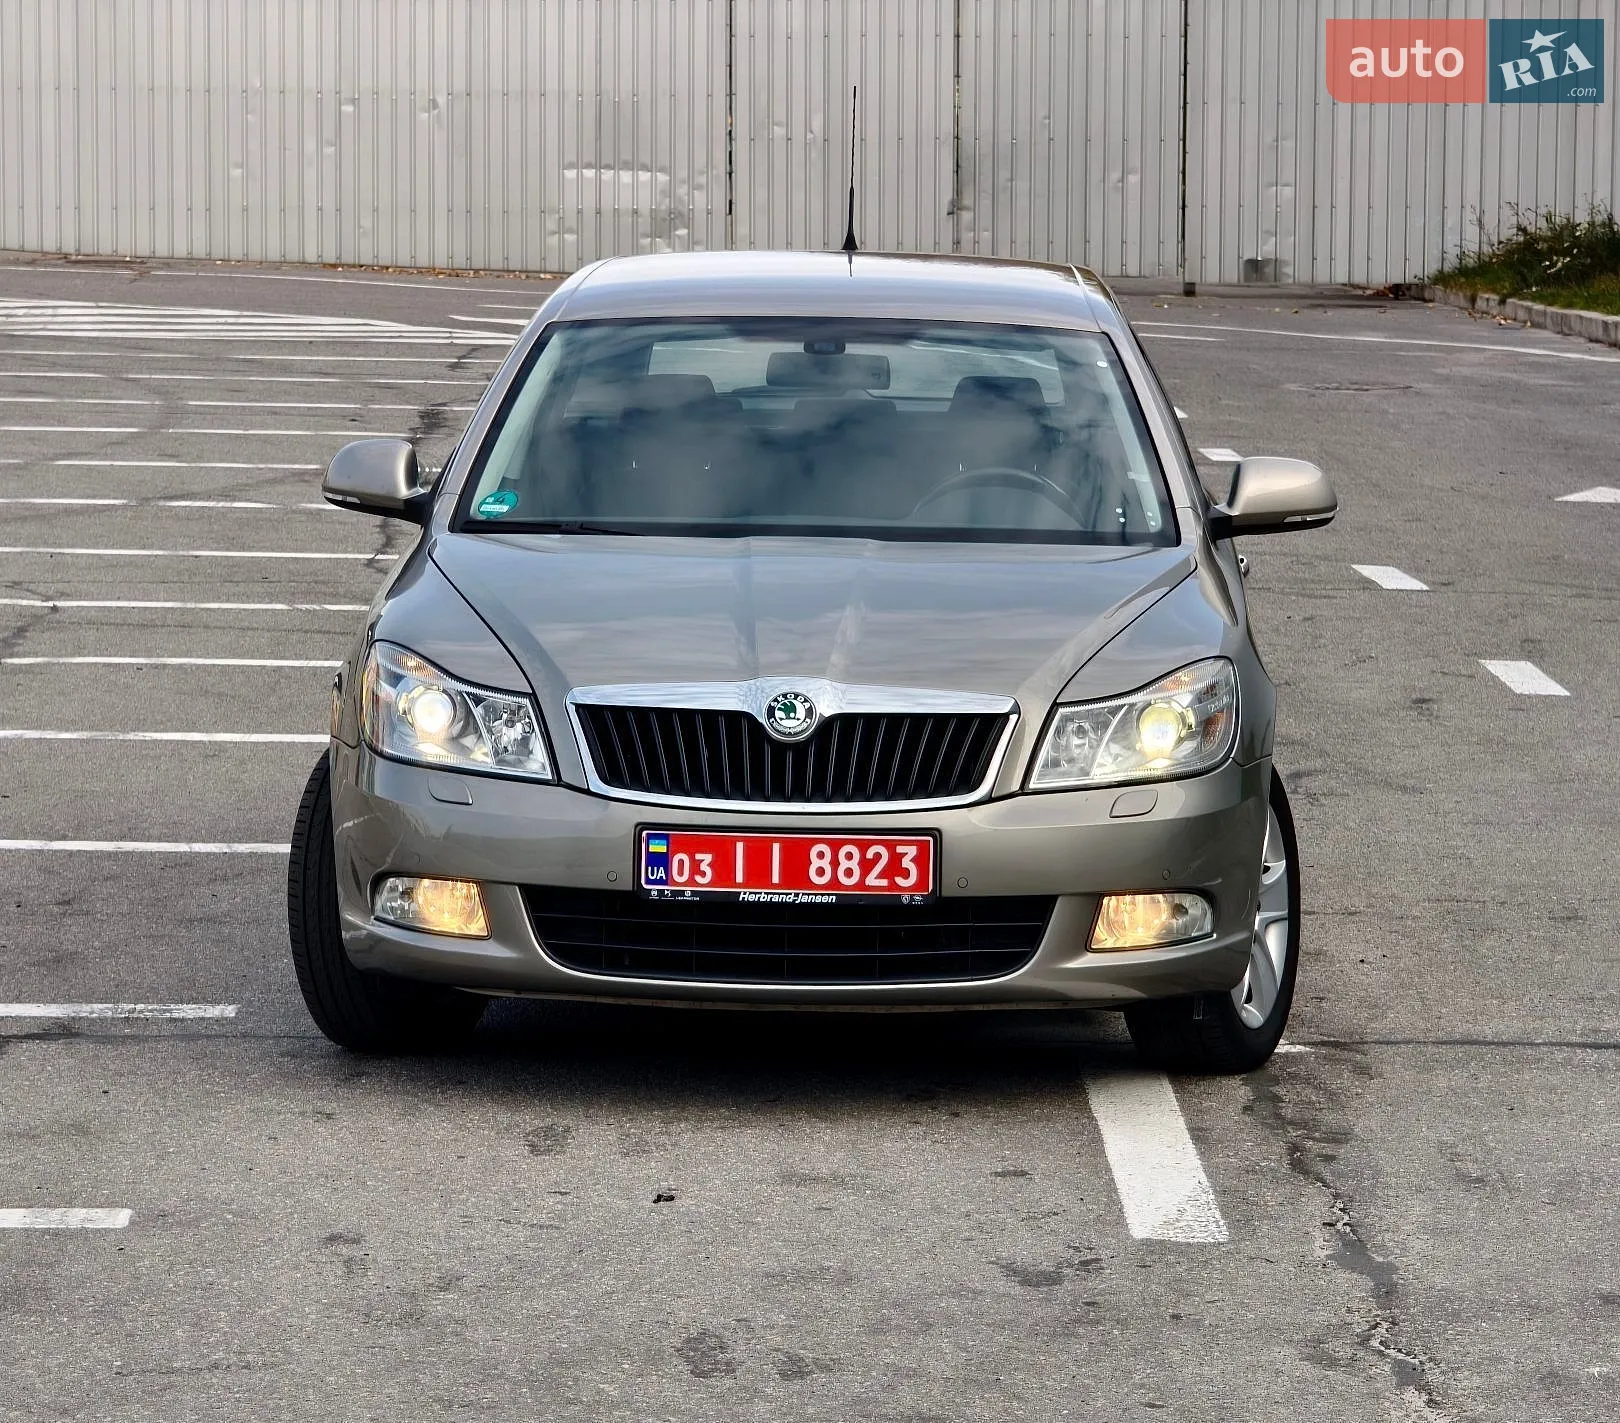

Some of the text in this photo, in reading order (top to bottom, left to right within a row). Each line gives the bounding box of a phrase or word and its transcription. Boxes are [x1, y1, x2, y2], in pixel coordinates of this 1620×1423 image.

[671, 852, 714, 884] 03
[808, 843, 918, 887] 8823
[647, 866, 666, 880] UA
[738, 891, 836, 904] Herbrand-Jansen
